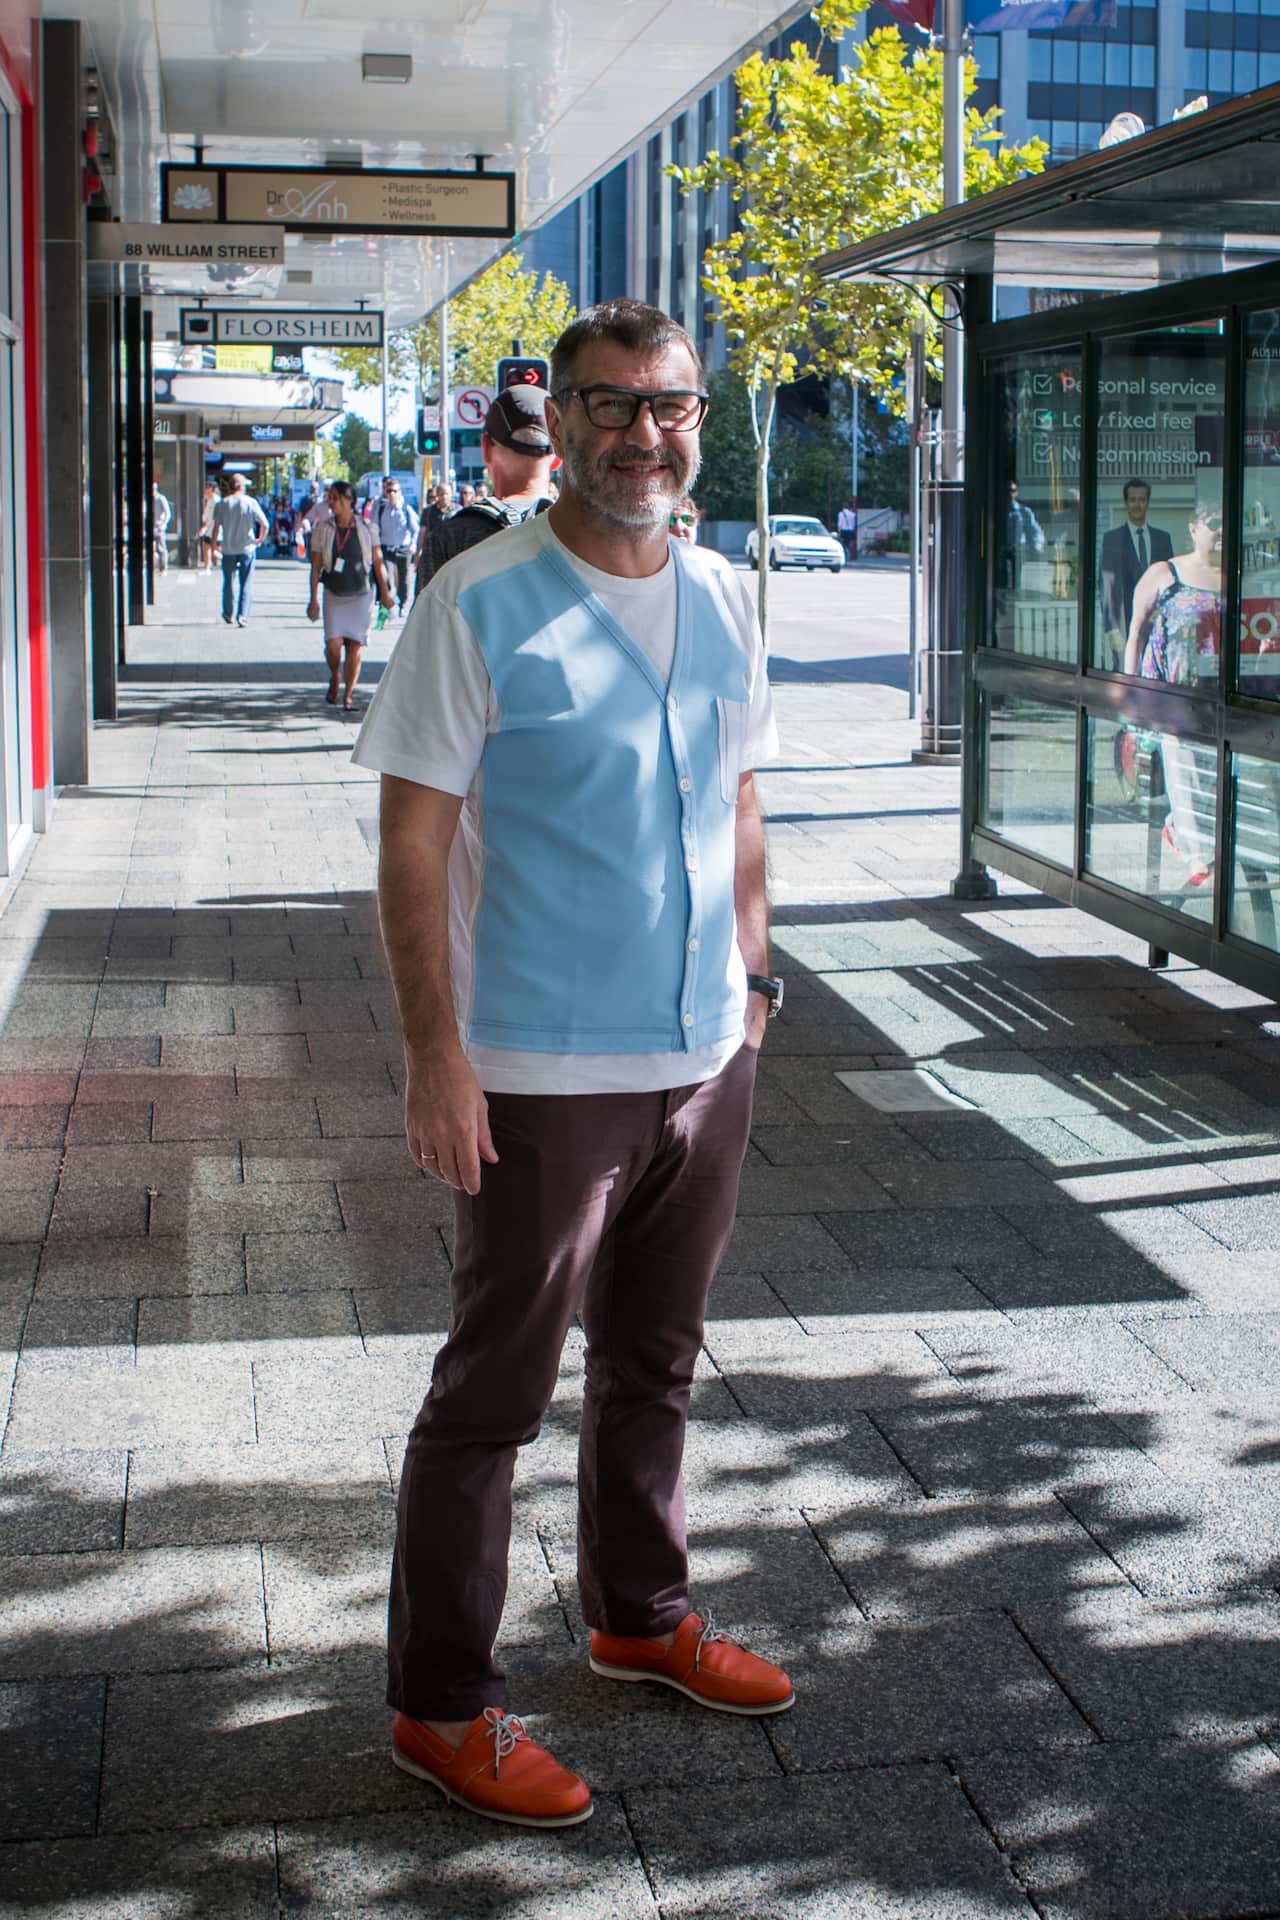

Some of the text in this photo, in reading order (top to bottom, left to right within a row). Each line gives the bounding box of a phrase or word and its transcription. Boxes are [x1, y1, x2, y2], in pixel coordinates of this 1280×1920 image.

[388, 182, 469, 196] Plastic Surgeon
[266, 180, 348, 220] Dr Anh
[388, 196, 432, 208] Medispa
[388, 210, 437, 221] Wellness
[125, 243, 278, 258] 88 WILLIAM STREET
[225, 319, 373, 336] FLORSHEIM
[1062, 377, 1217, 395] Pesonal service
[1108, 411, 1156, 429] fixed
[1161, 412, 1193, 429] fee
[251, 424, 283, 438] Stefan
[1097, 446, 1211, 464] commission
